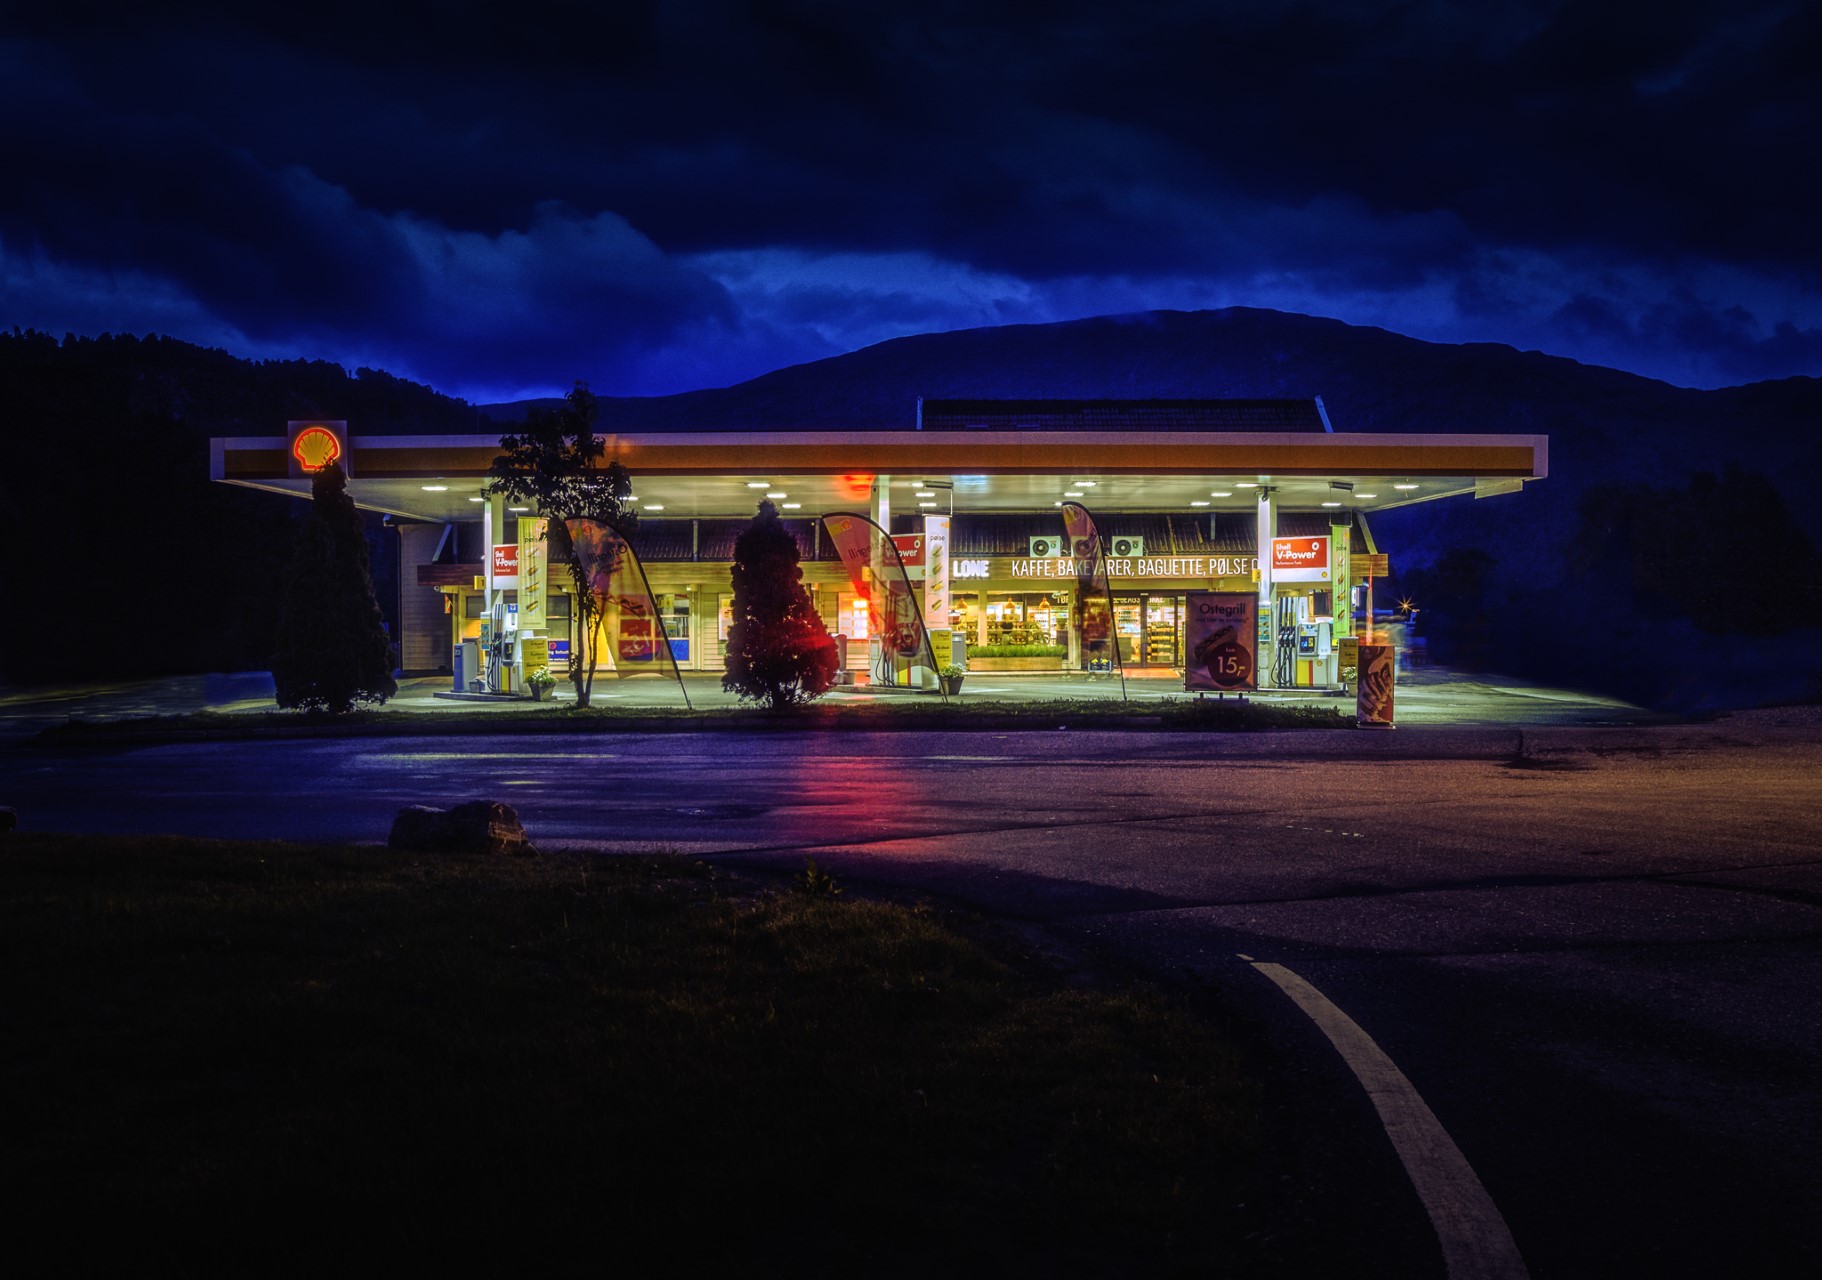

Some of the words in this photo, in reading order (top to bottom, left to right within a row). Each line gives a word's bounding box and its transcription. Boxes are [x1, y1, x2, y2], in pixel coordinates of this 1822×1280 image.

[495, 558, 518, 567] V-Power
[1276, 550, 1317, 560] V-Power
[953, 560, 990, 577] LONE
[1012, 560, 1055, 578] KAFFE,
[1138, 559, 1207, 577] BAGUETTE,
[1209, 558, 1248, 576] PØLSE
[1200, 602, 1246, 617] Ostegrill
[1217, 655, 1246, 677] 15,-
